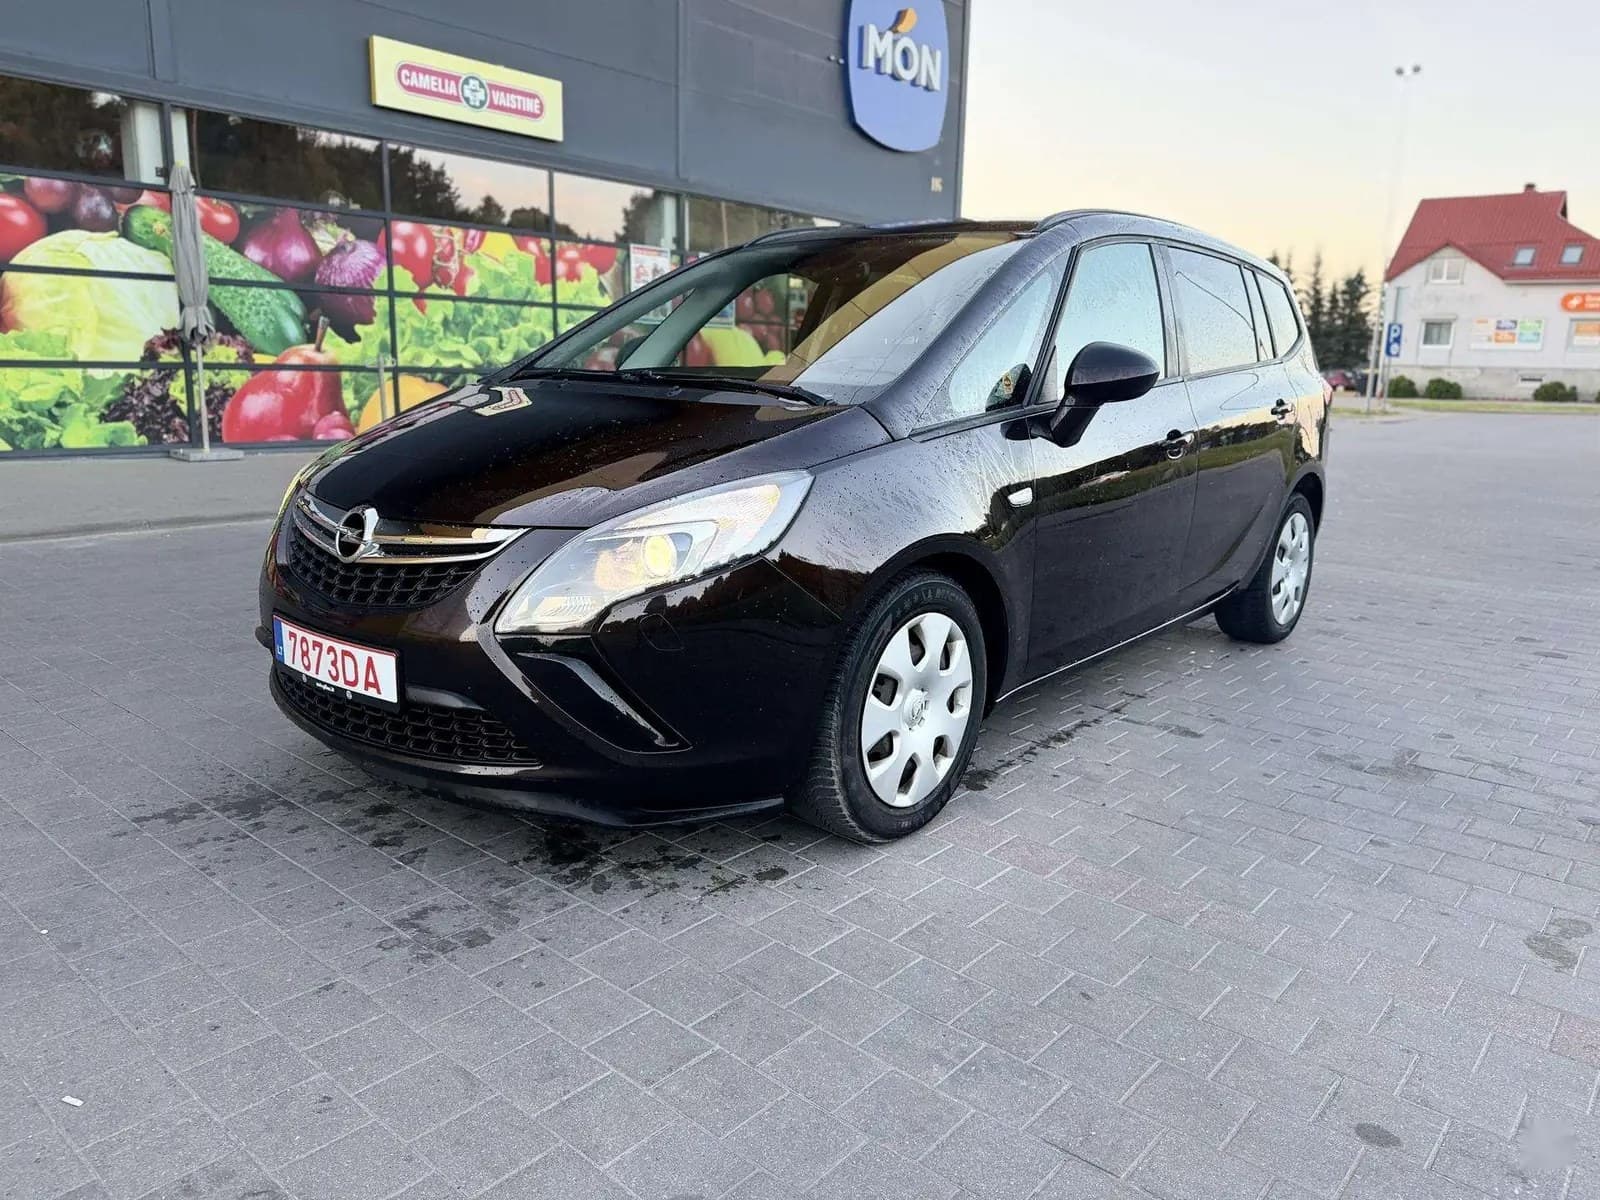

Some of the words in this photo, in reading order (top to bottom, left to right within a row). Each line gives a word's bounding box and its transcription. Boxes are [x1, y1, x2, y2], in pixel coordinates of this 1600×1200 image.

[862, 23, 942, 92] MON
[400, 68, 459, 97] CAMELIA
[491, 90, 541, 114] VAISTINĖ
[1390, 324, 1401, 343] P
[288, 630, 382, 695] 7873DA
